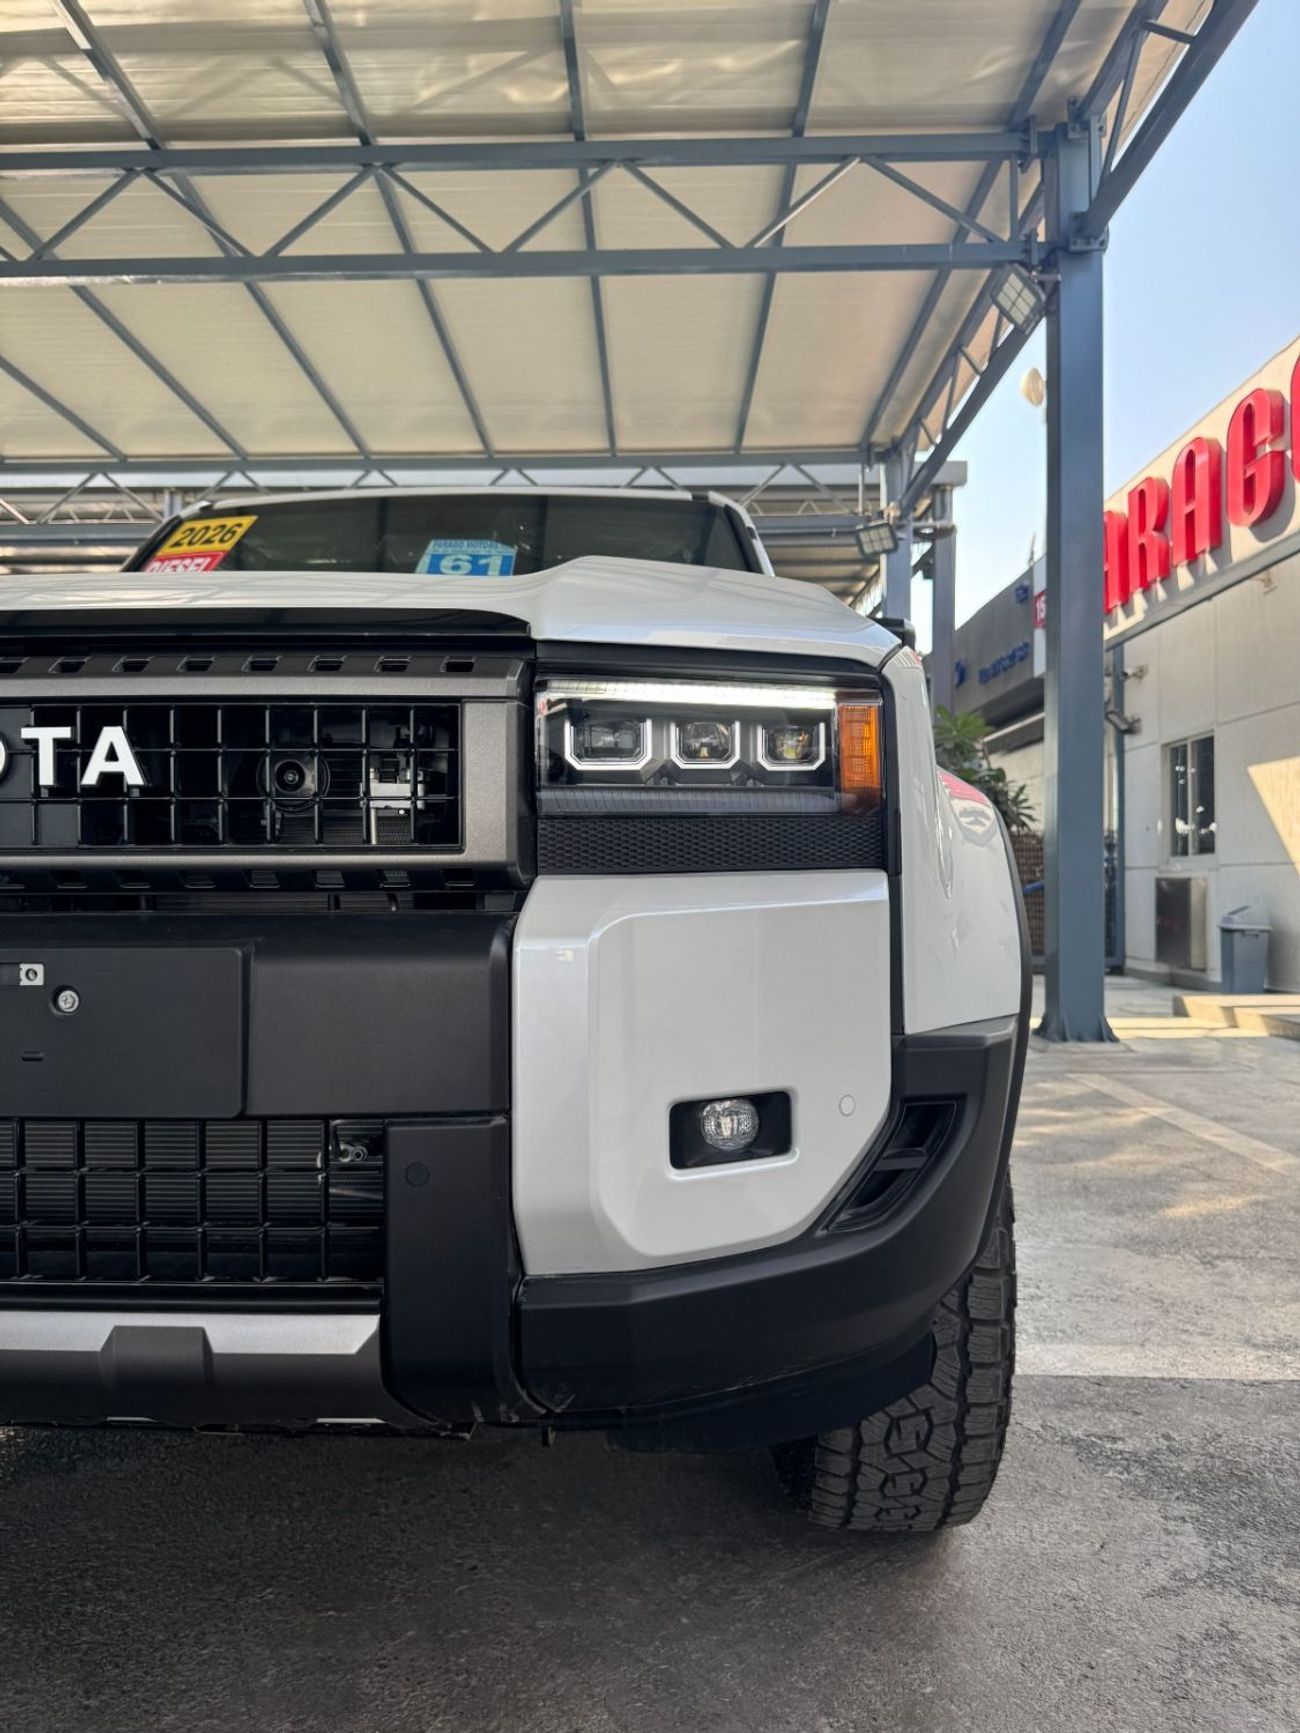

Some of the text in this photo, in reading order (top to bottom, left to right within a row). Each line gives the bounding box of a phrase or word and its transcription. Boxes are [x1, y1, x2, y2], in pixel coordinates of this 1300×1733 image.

[1103, 352, 1300, 614] ARAG
[169, 523, 243, 548] 2026
[439, 555, 503, 576] 61
[0, 726, 145, 786] TA
